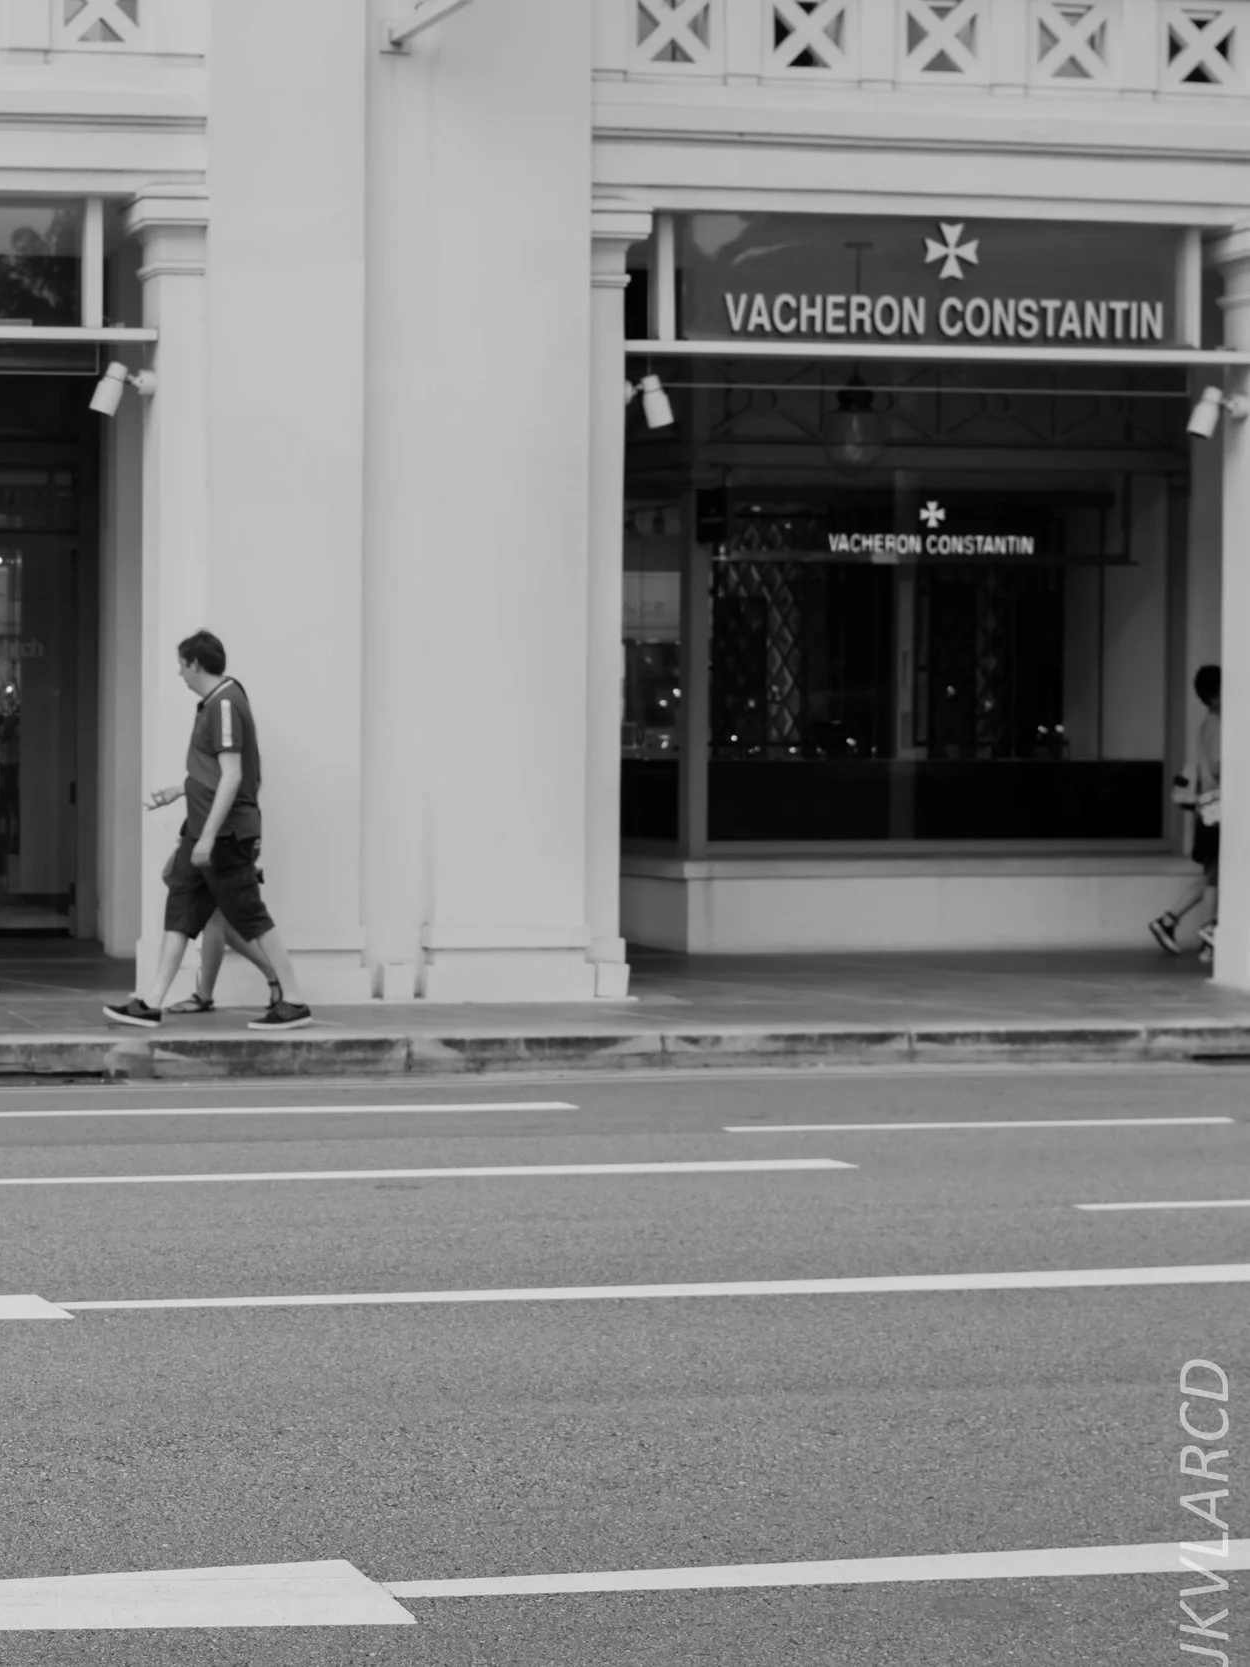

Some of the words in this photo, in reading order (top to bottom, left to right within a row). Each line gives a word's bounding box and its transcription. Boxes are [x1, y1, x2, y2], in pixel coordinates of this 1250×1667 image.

[724, 293, 926, 336] VACHERON
[938, 297, 1164, 340] CONSTANTIN
[828, 533, 922, 553] VACHERON
[925, 534, 1035, 555] CONSTANTIN
